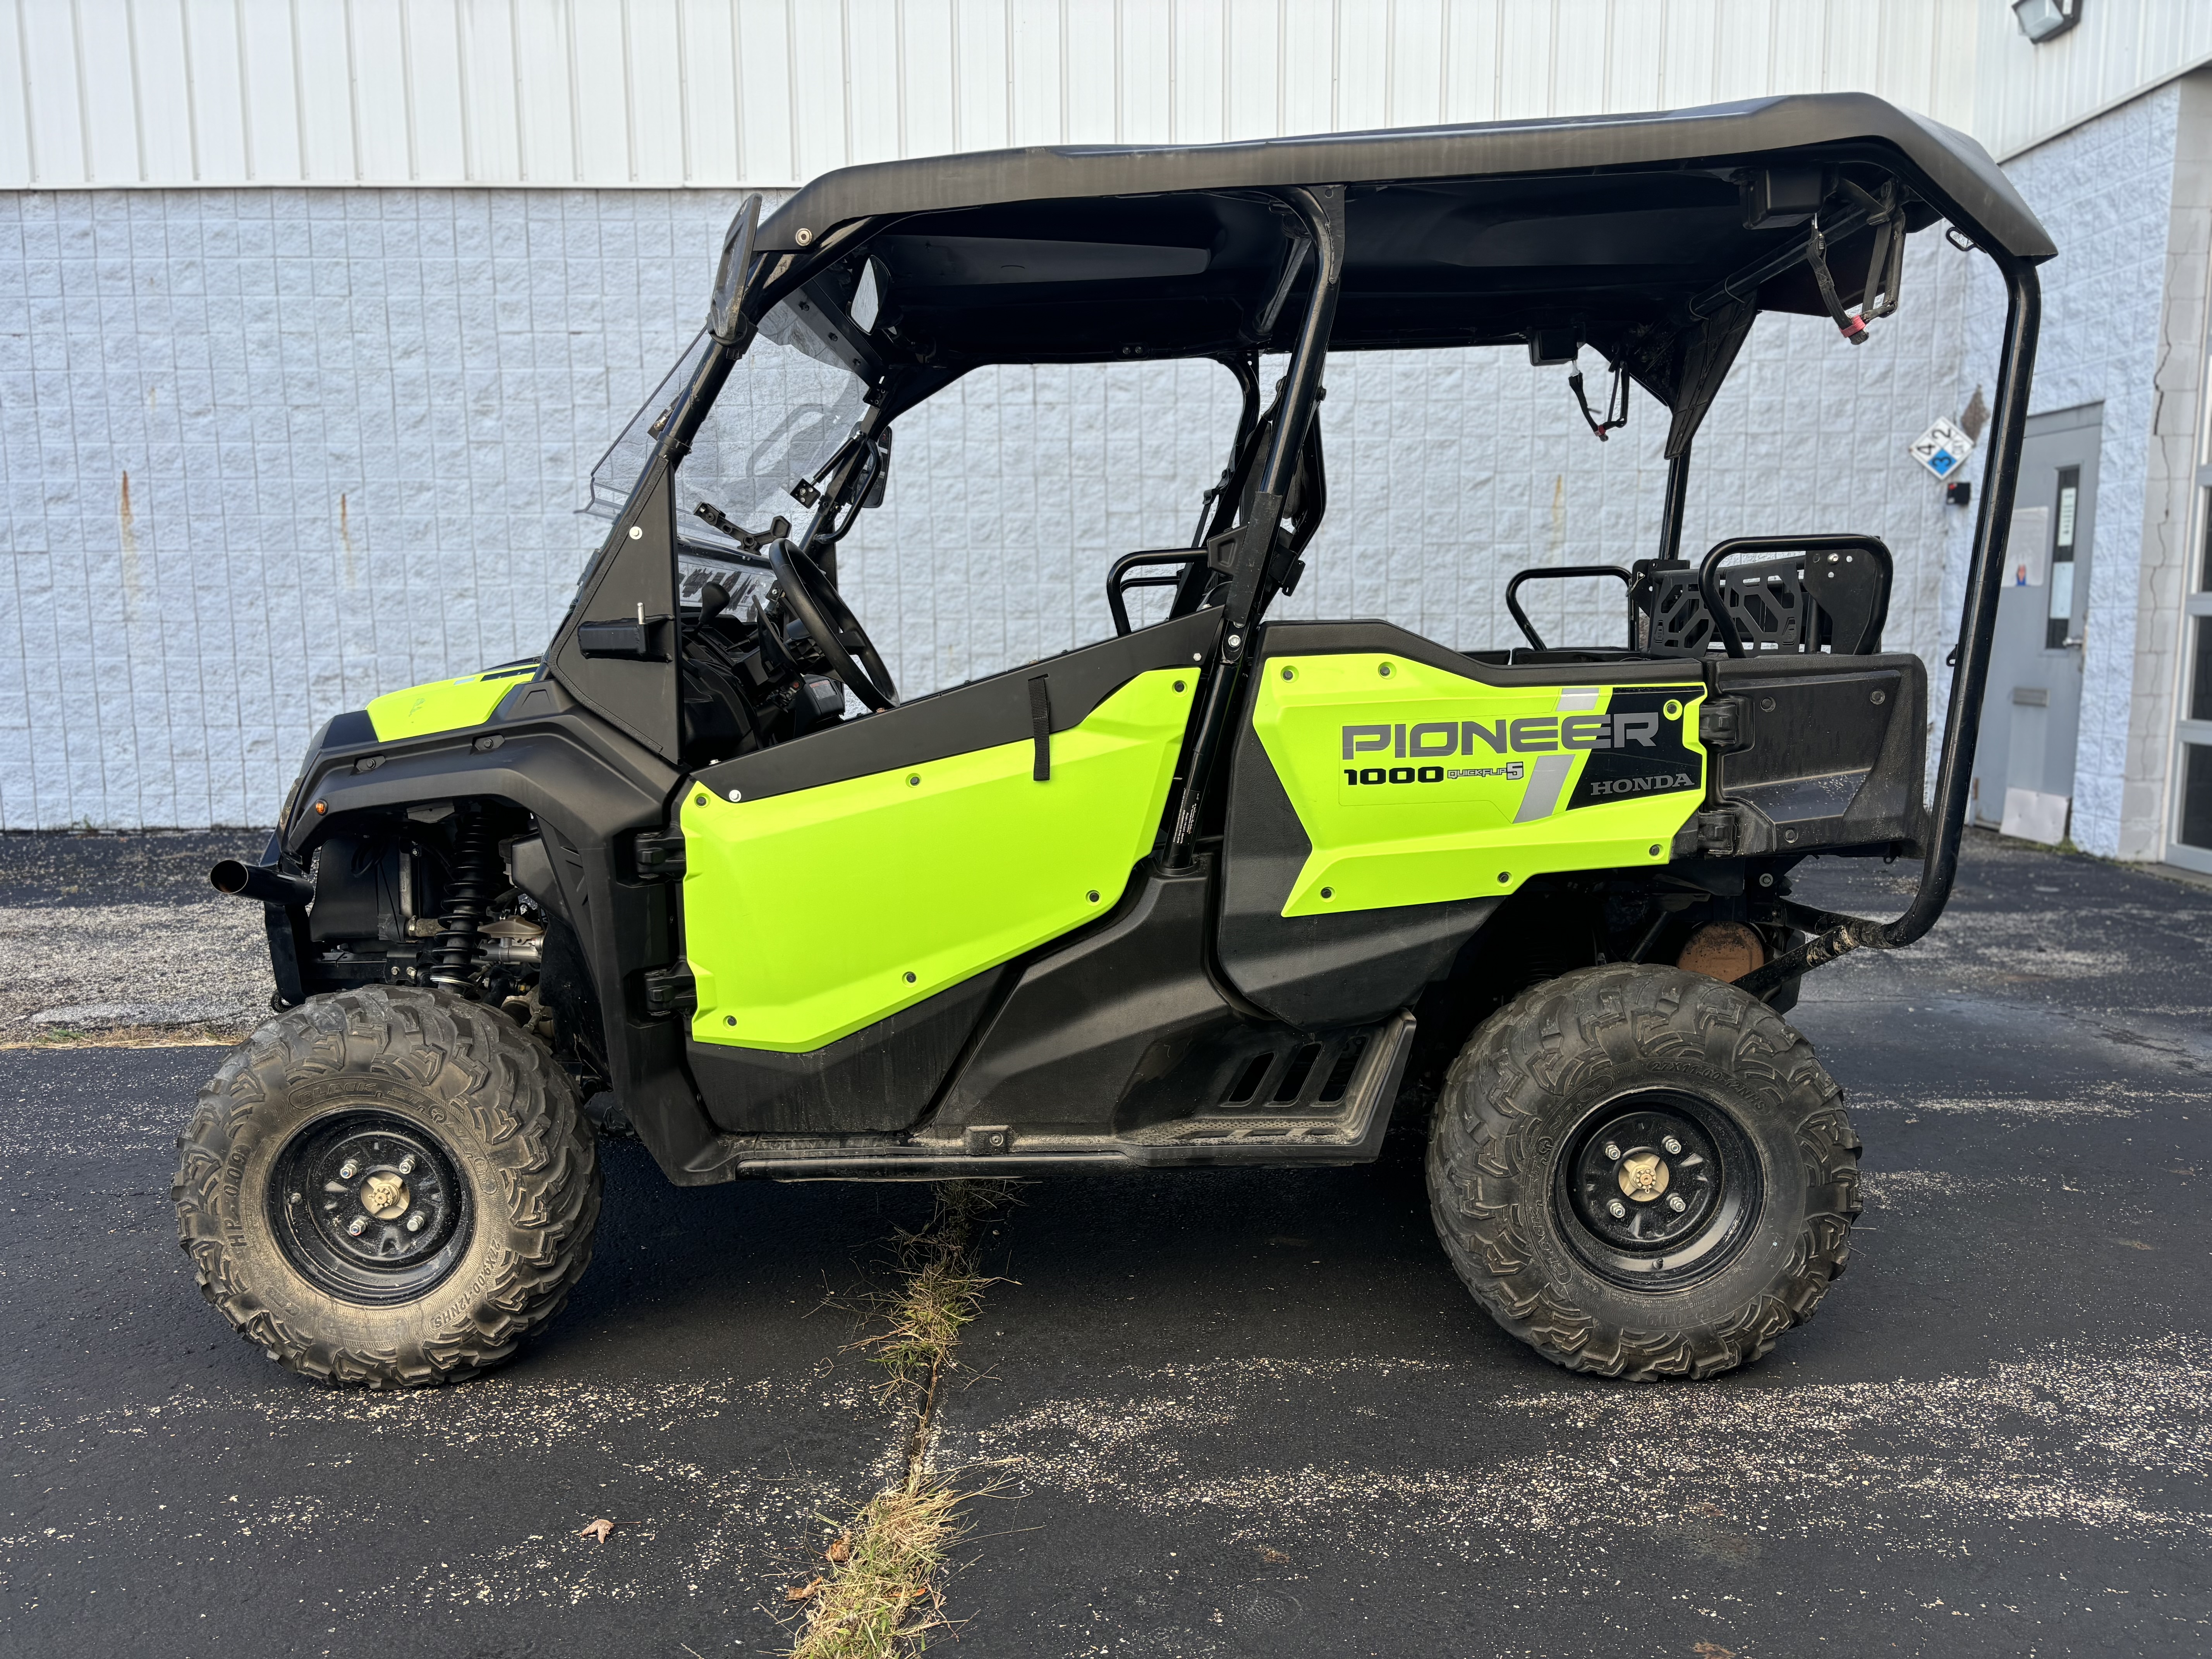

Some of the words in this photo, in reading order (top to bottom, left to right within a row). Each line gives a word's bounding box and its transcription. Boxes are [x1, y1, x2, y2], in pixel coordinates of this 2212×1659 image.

[1932, 429, 1951, 439] 2
[1917, 444, 1936, 455] 4
[1933, 457, 1952, 467] 3
[1342, 712, 1659, 760] PIONEER
[1344, 766, 1444, 785] 1000
[1590, 773, 1695, 795] HONDA
